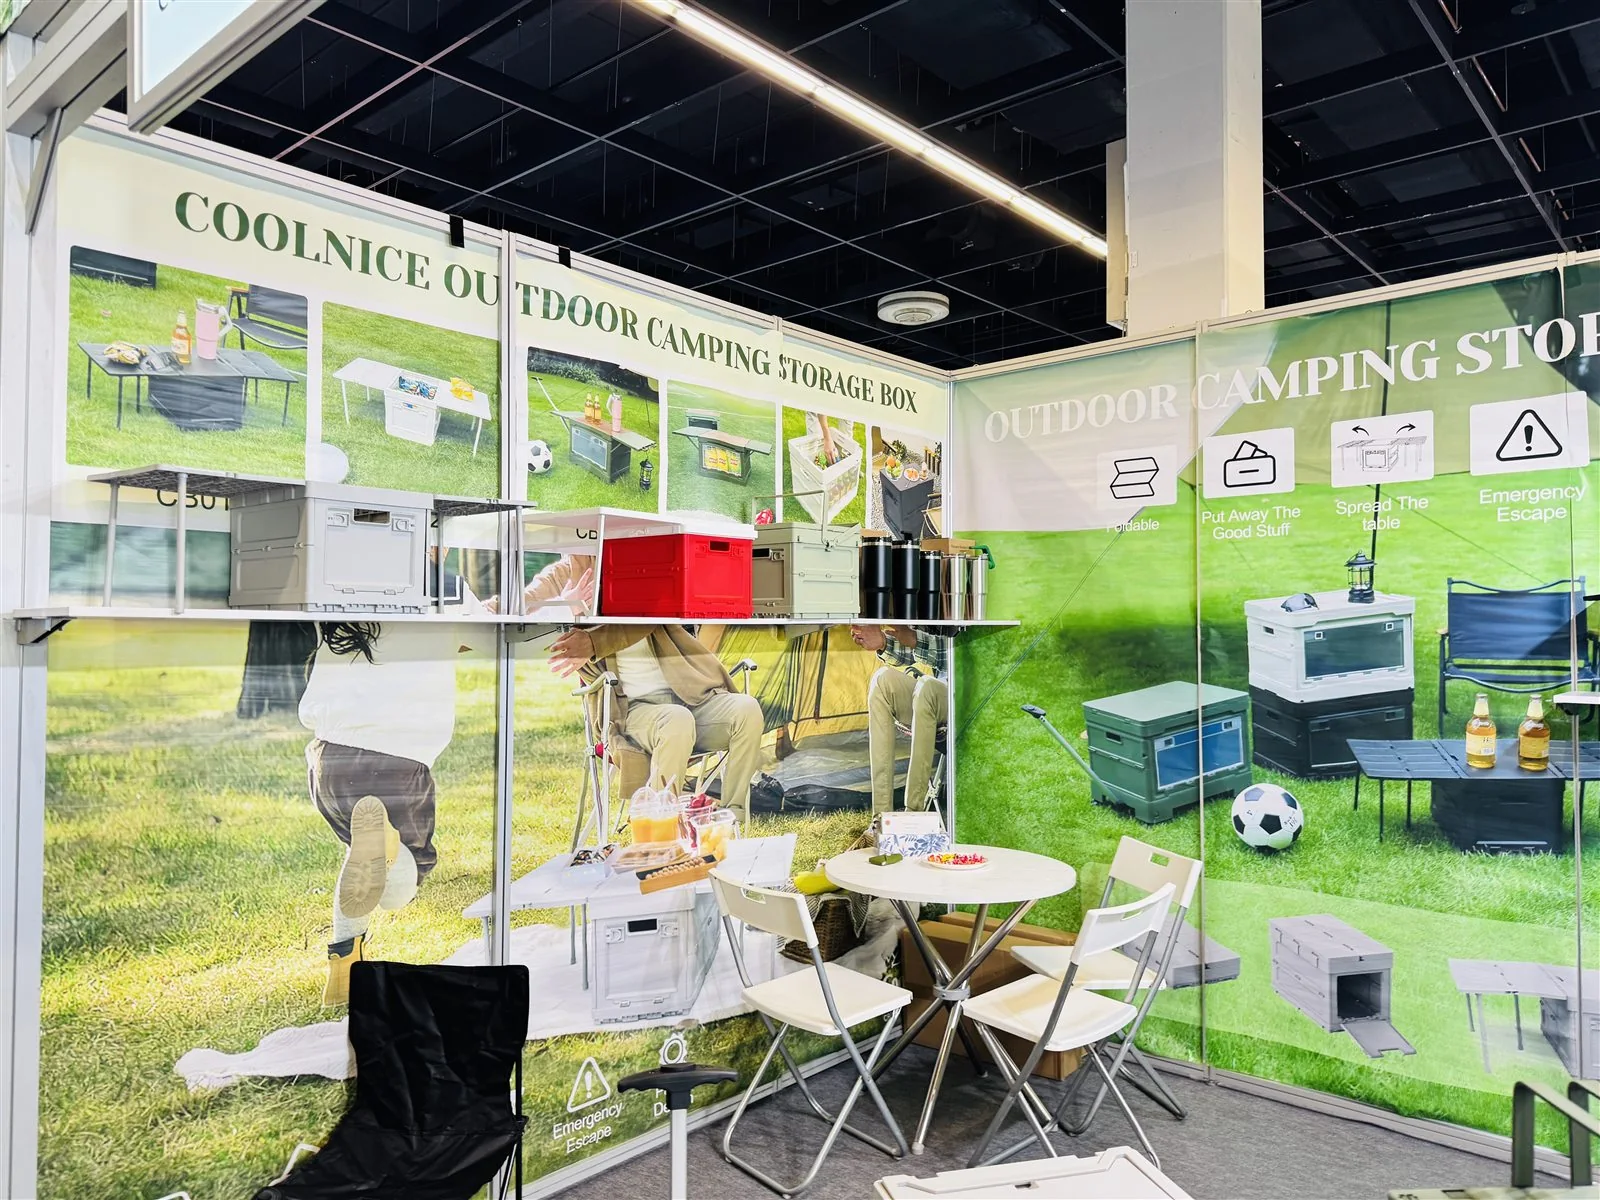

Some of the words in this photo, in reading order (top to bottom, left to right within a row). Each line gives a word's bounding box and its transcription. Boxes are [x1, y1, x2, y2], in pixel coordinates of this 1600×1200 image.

[174, 191, 431, 291] COOLNICE
[443, 263, 640, 341] OUTDOOR
[646, 316, 772, 376] CAMPING
[778, 353, 875, 403] STORAGE
[879, 382, 919, 414] BOX
[984, 383, 1181, 443] OUTDOOR
[1190, 338, 1441, 411] CAMPING
[1479, 483, 1588, 505] Emergency
[1201, 511, 1225, 525] Put
[1227, 508, 1269, 524] Away
[1272, 505, 1301, 519] The
[1335, 497, 1393, 517] Spread
[1398, 495, 1430, 511] The
[1496, 506, 1568, 523] Escape
[1212, 525, 1252, 540] Good
[1256, 522, 1292, 537] Stuff
[1362, 515, 1401, 531] table
[553, 1101, 625, 1140] Emergency
[566, 1126, 613, 1154] Escape
